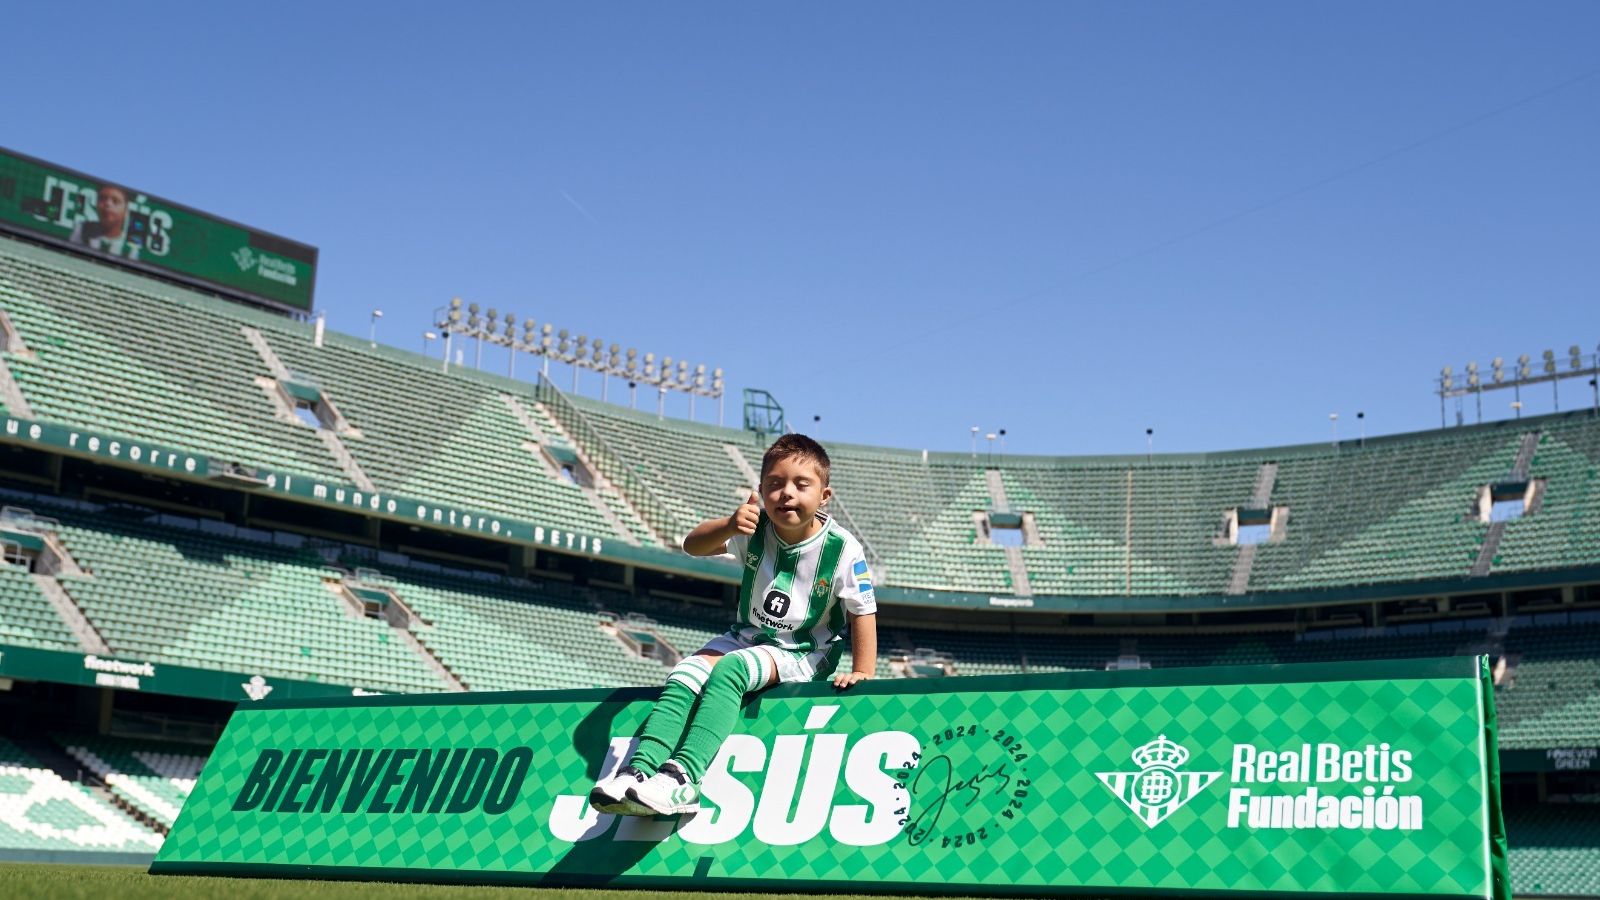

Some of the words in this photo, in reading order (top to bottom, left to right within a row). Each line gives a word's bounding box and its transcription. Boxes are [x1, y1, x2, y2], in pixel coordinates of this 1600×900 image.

[69, 431, 196, 472] recorre
[266, 474, 292, 491] el
[313, 483, 397, 512] mundo
[534, 526, 602, 554] BETIS
[752, 607, 794, 630] finetwork
[933, 724, 977, 746] 2024
[992, 730, 1028, 762] 2024
[231, 746, 534, 815] BIENVENIDO
[549, 705, 921, 846] JSÚS
[894, 751, 923, 789] 2024
[1231, 743, 1311, 783] Real
[1316, 742, 1412, 783] Betis
[1001, 779, 1031, 820] 2024
[1227, 785, 1423, 830] Fundación
[941, 827, 988, 848] 2024
